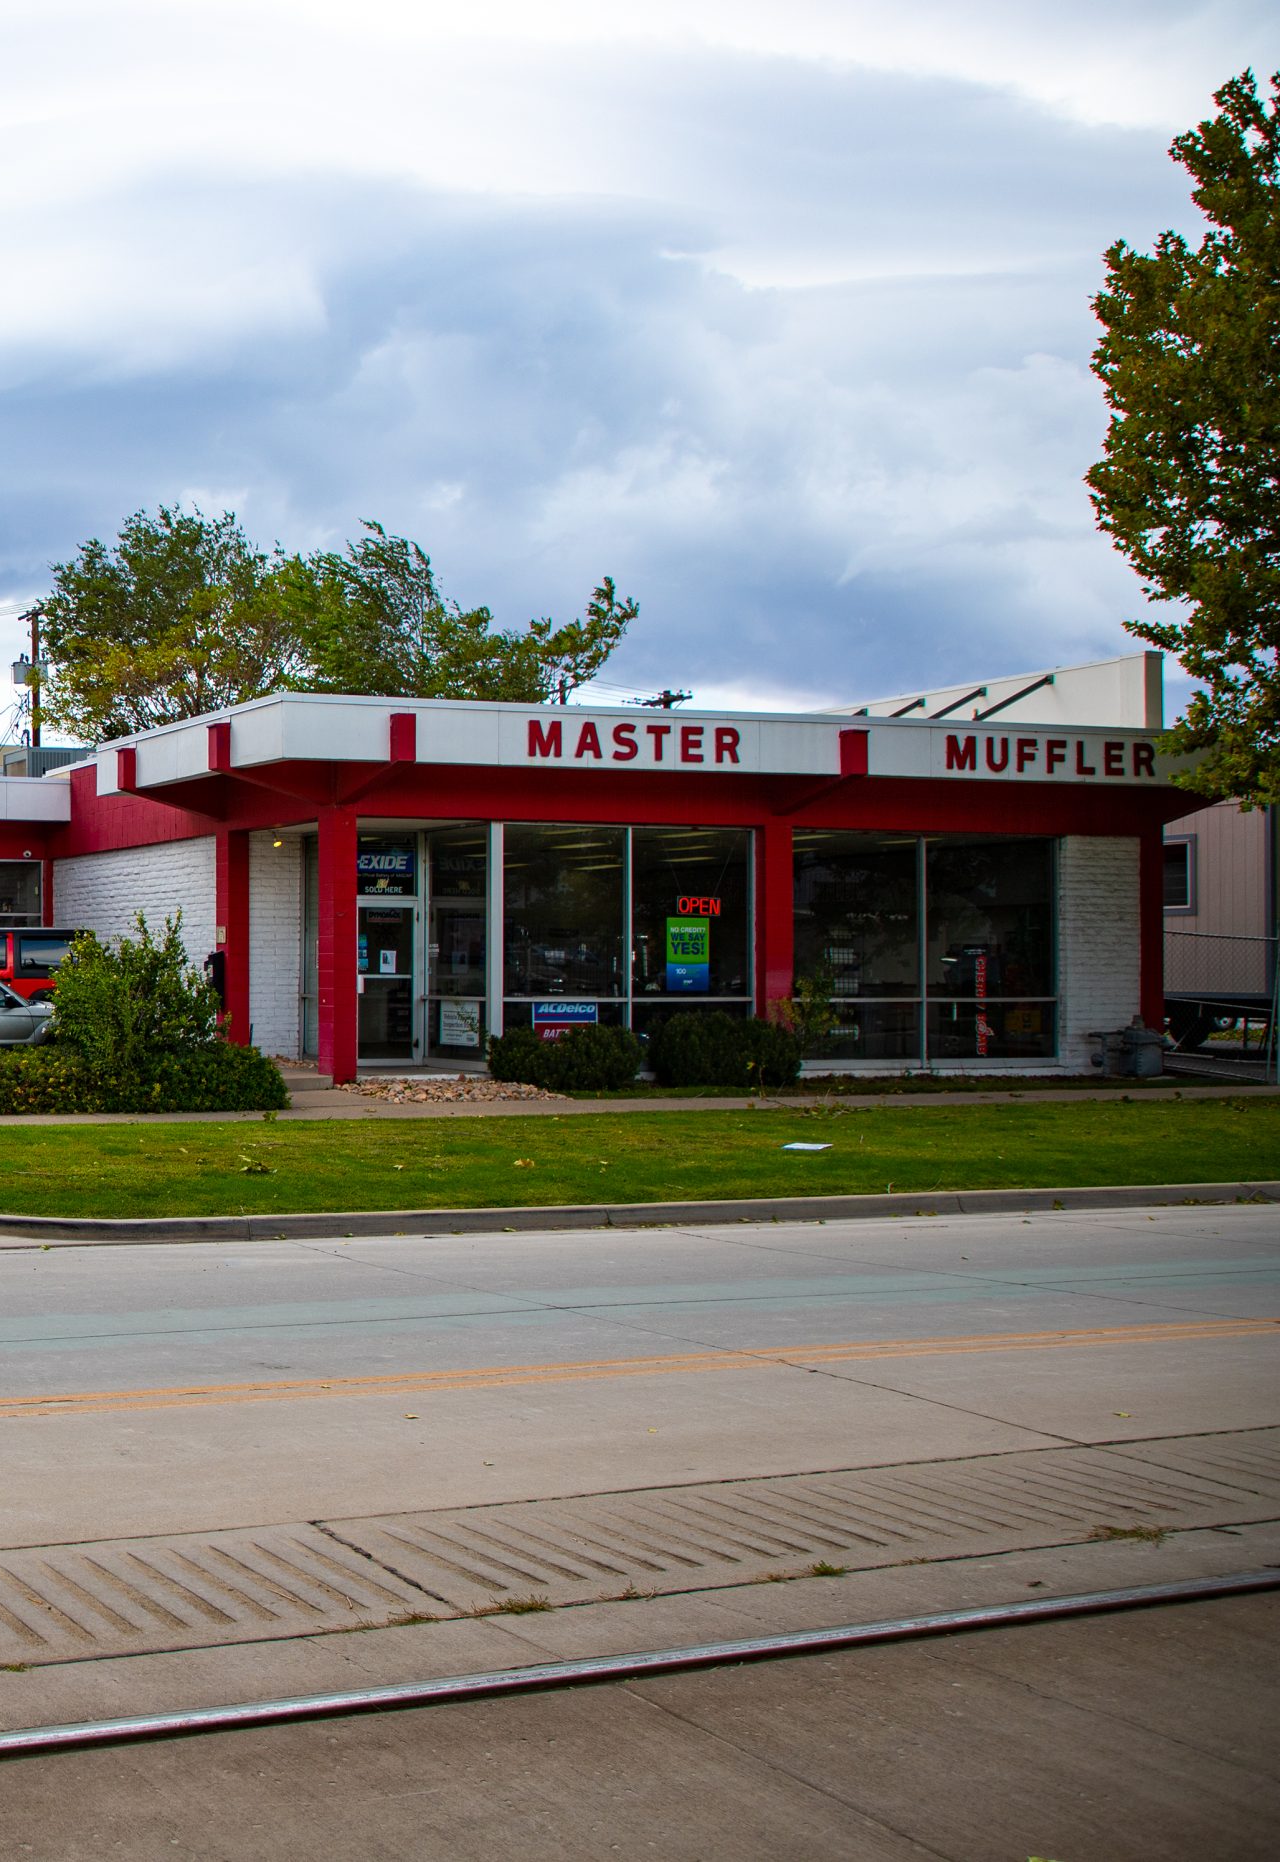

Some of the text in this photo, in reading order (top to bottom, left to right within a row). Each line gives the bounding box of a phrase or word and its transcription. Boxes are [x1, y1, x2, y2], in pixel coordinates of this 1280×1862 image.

[528, 720, 1155, 777] MASTER MUFFLER
[358, 855, 408, 870] EXIDE
[385, 886, 403, 894] HERE
[678, 897, 721, 915] OPEN
[671, 933, 706, 942] WE SAY
[671, 942, 705, 955] YES!
[538, 1003, 596, 1014] ACDelco
